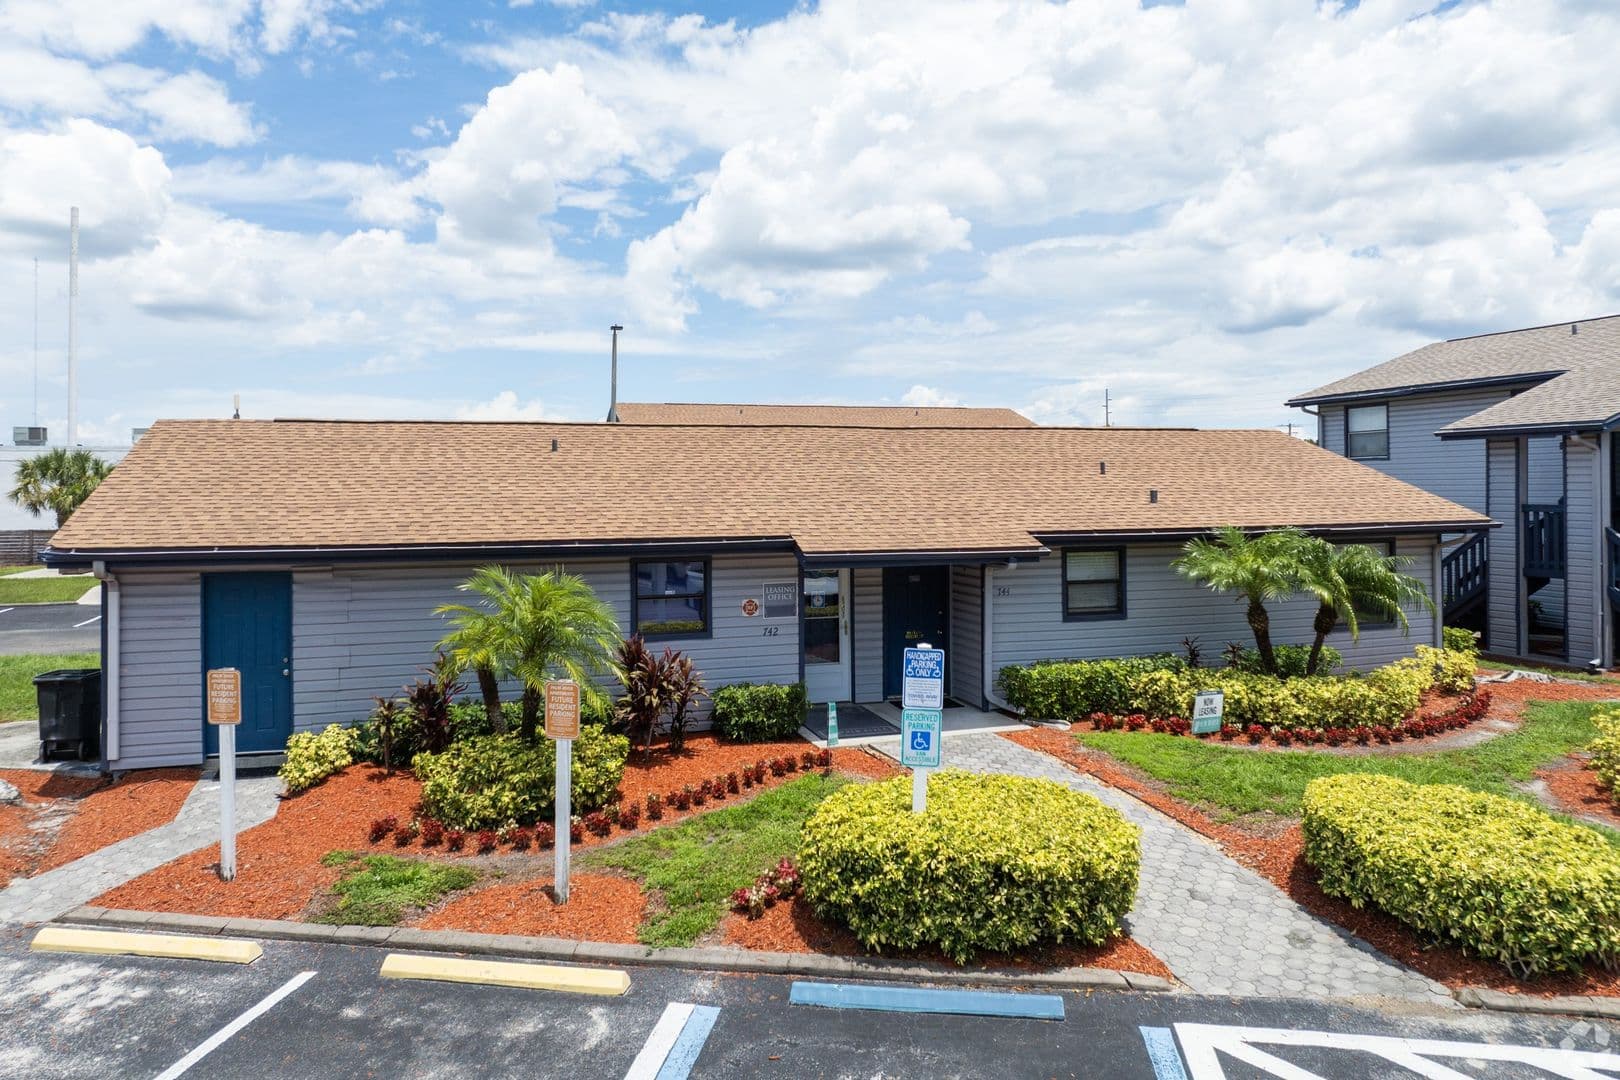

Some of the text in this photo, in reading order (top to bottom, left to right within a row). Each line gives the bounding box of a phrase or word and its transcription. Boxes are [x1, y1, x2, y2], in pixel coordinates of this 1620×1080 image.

[765, 586, 796, 594] LEASING
[768, 593, 793, 601] OFFICE
[762, 626, 779, 637] 742
[906, 651, 942, 661] HANDICAPPED
[911, 660, 937, 670] PARKING
[915, 669, 931, 677] ONLY
[549, 710, 576, 718] PARKING
[1199, 706, 1217, 716] LEASING
[905, 713, 939, 722] RESERVED
[908, 722, 936, 730] PARKING
